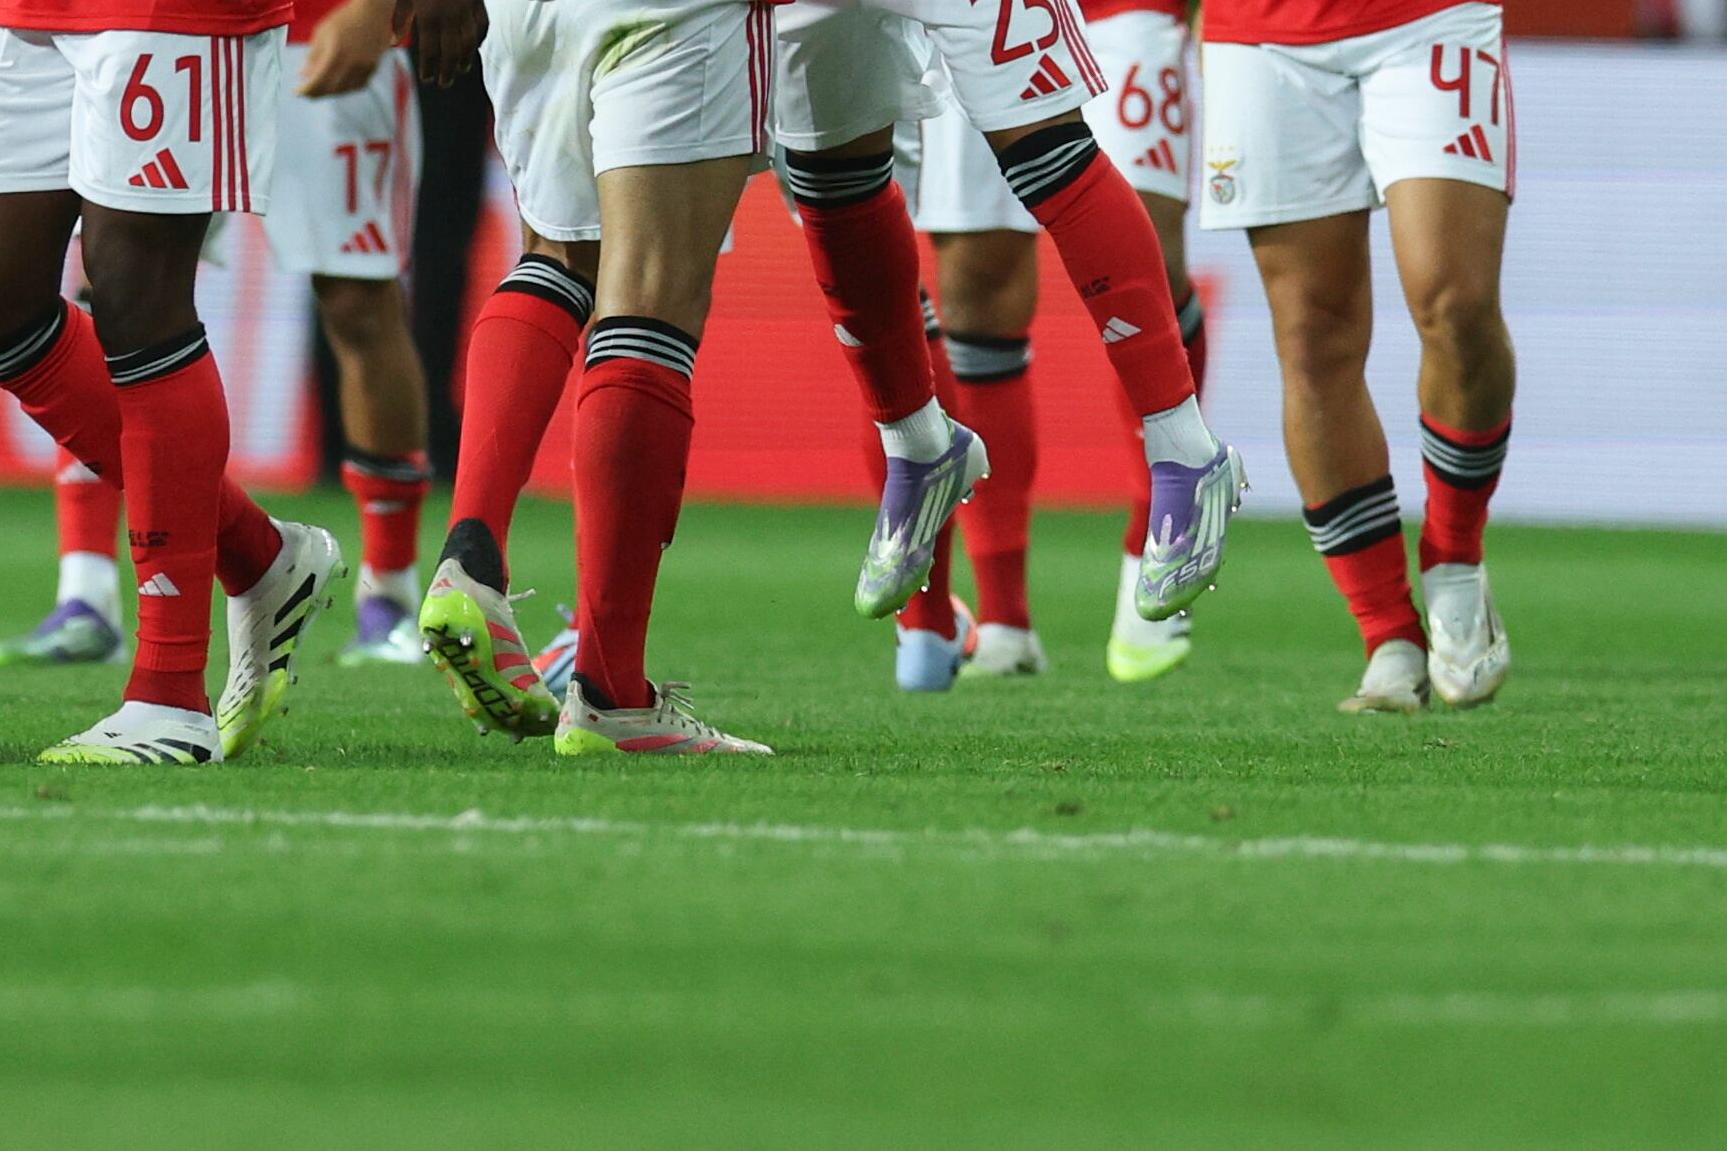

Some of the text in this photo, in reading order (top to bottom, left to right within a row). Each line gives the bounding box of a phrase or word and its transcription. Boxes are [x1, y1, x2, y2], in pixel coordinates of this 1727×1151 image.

[120, 54, 201, 142] 61
[1118, 63, 1186, 134] 68
[1431, 44, 1501, 126] 47
[335, 139, 391, 214] 17
